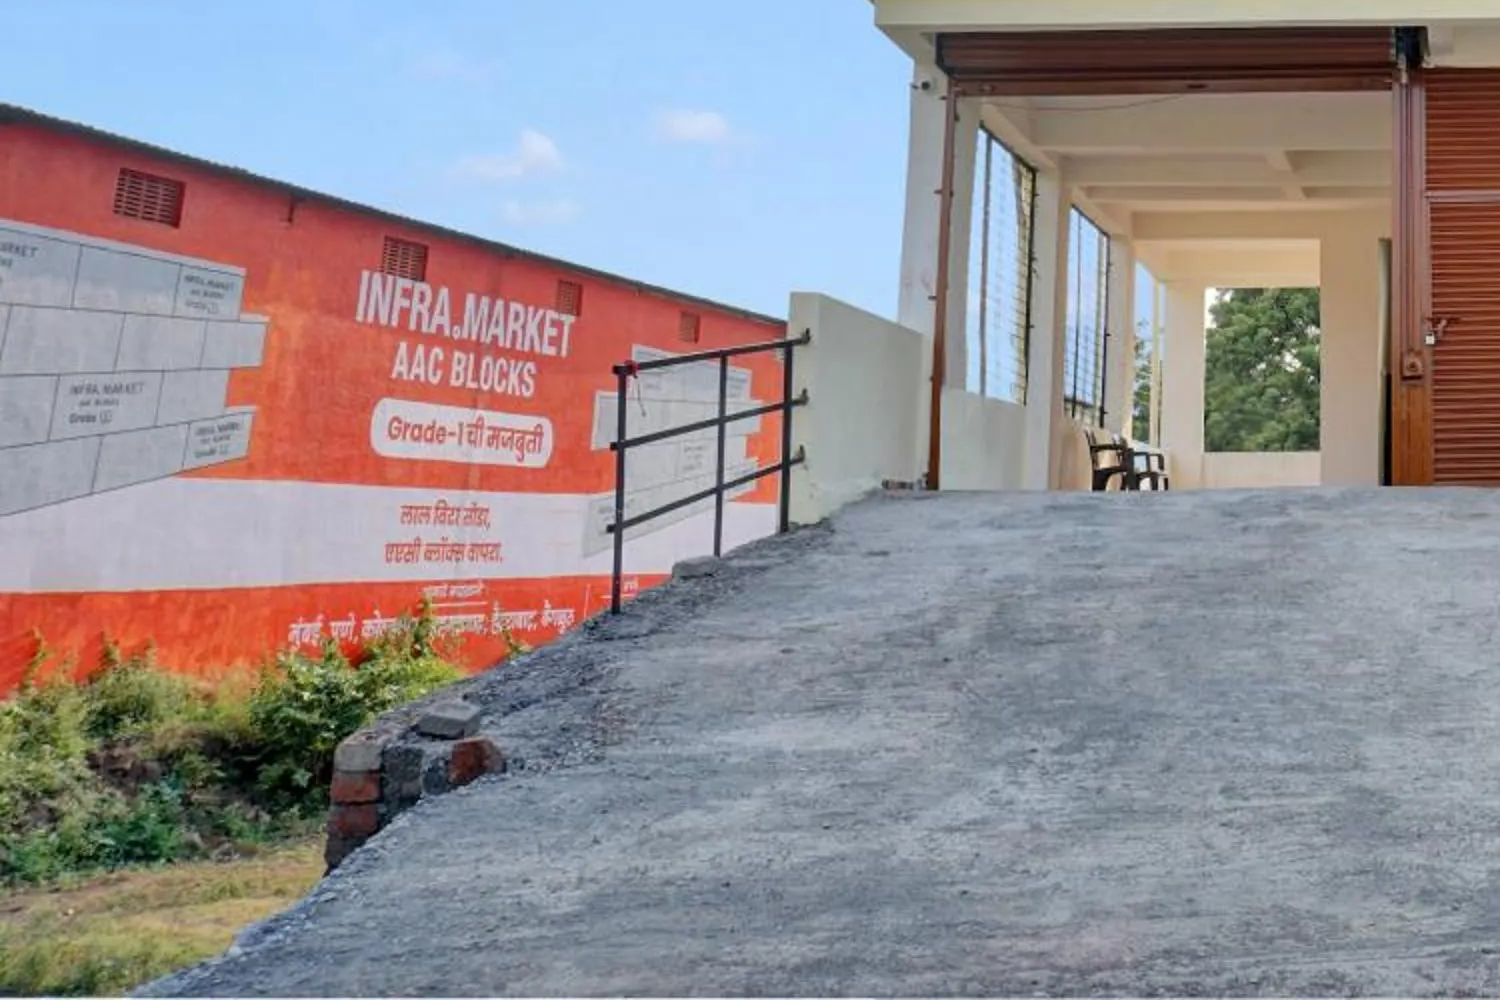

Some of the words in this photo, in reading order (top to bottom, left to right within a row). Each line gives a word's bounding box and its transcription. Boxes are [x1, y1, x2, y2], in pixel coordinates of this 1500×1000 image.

[391, 341, 444, 385] AAC
[450, 350, 536, 397] BLOCKS
[400, 505, 432, 526] लाल
